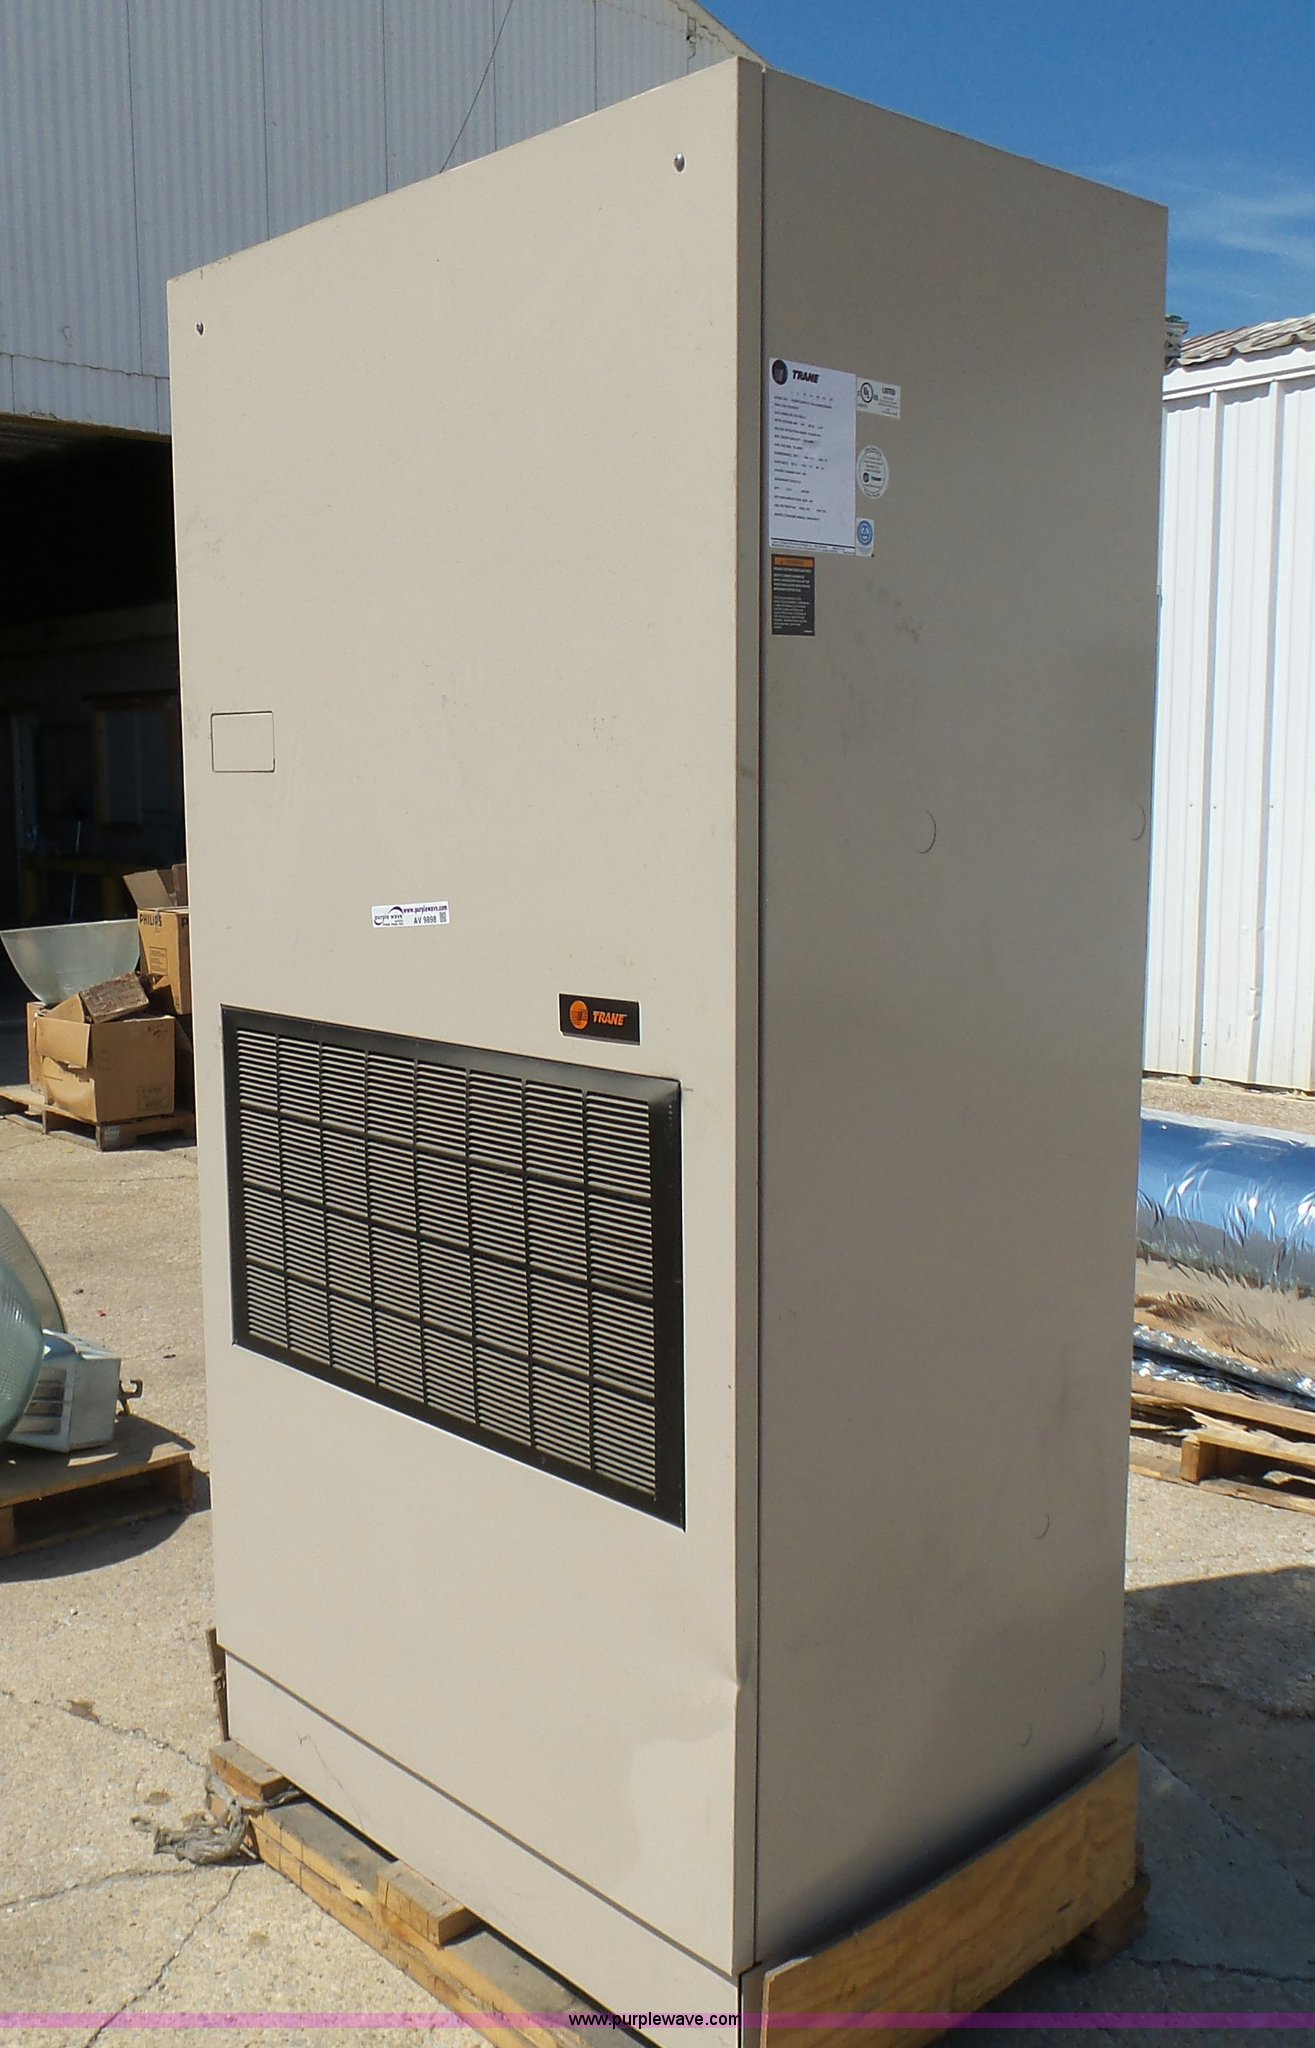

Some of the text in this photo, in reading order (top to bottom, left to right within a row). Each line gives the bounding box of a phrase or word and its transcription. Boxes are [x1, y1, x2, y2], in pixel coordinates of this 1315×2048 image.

[792, 369, 820, 384] TRANE
[140, 913, 162, 927] PHILIPS
[413, 916, 422, 925] AV
[592, 1010, 625, 1026] TRANE
